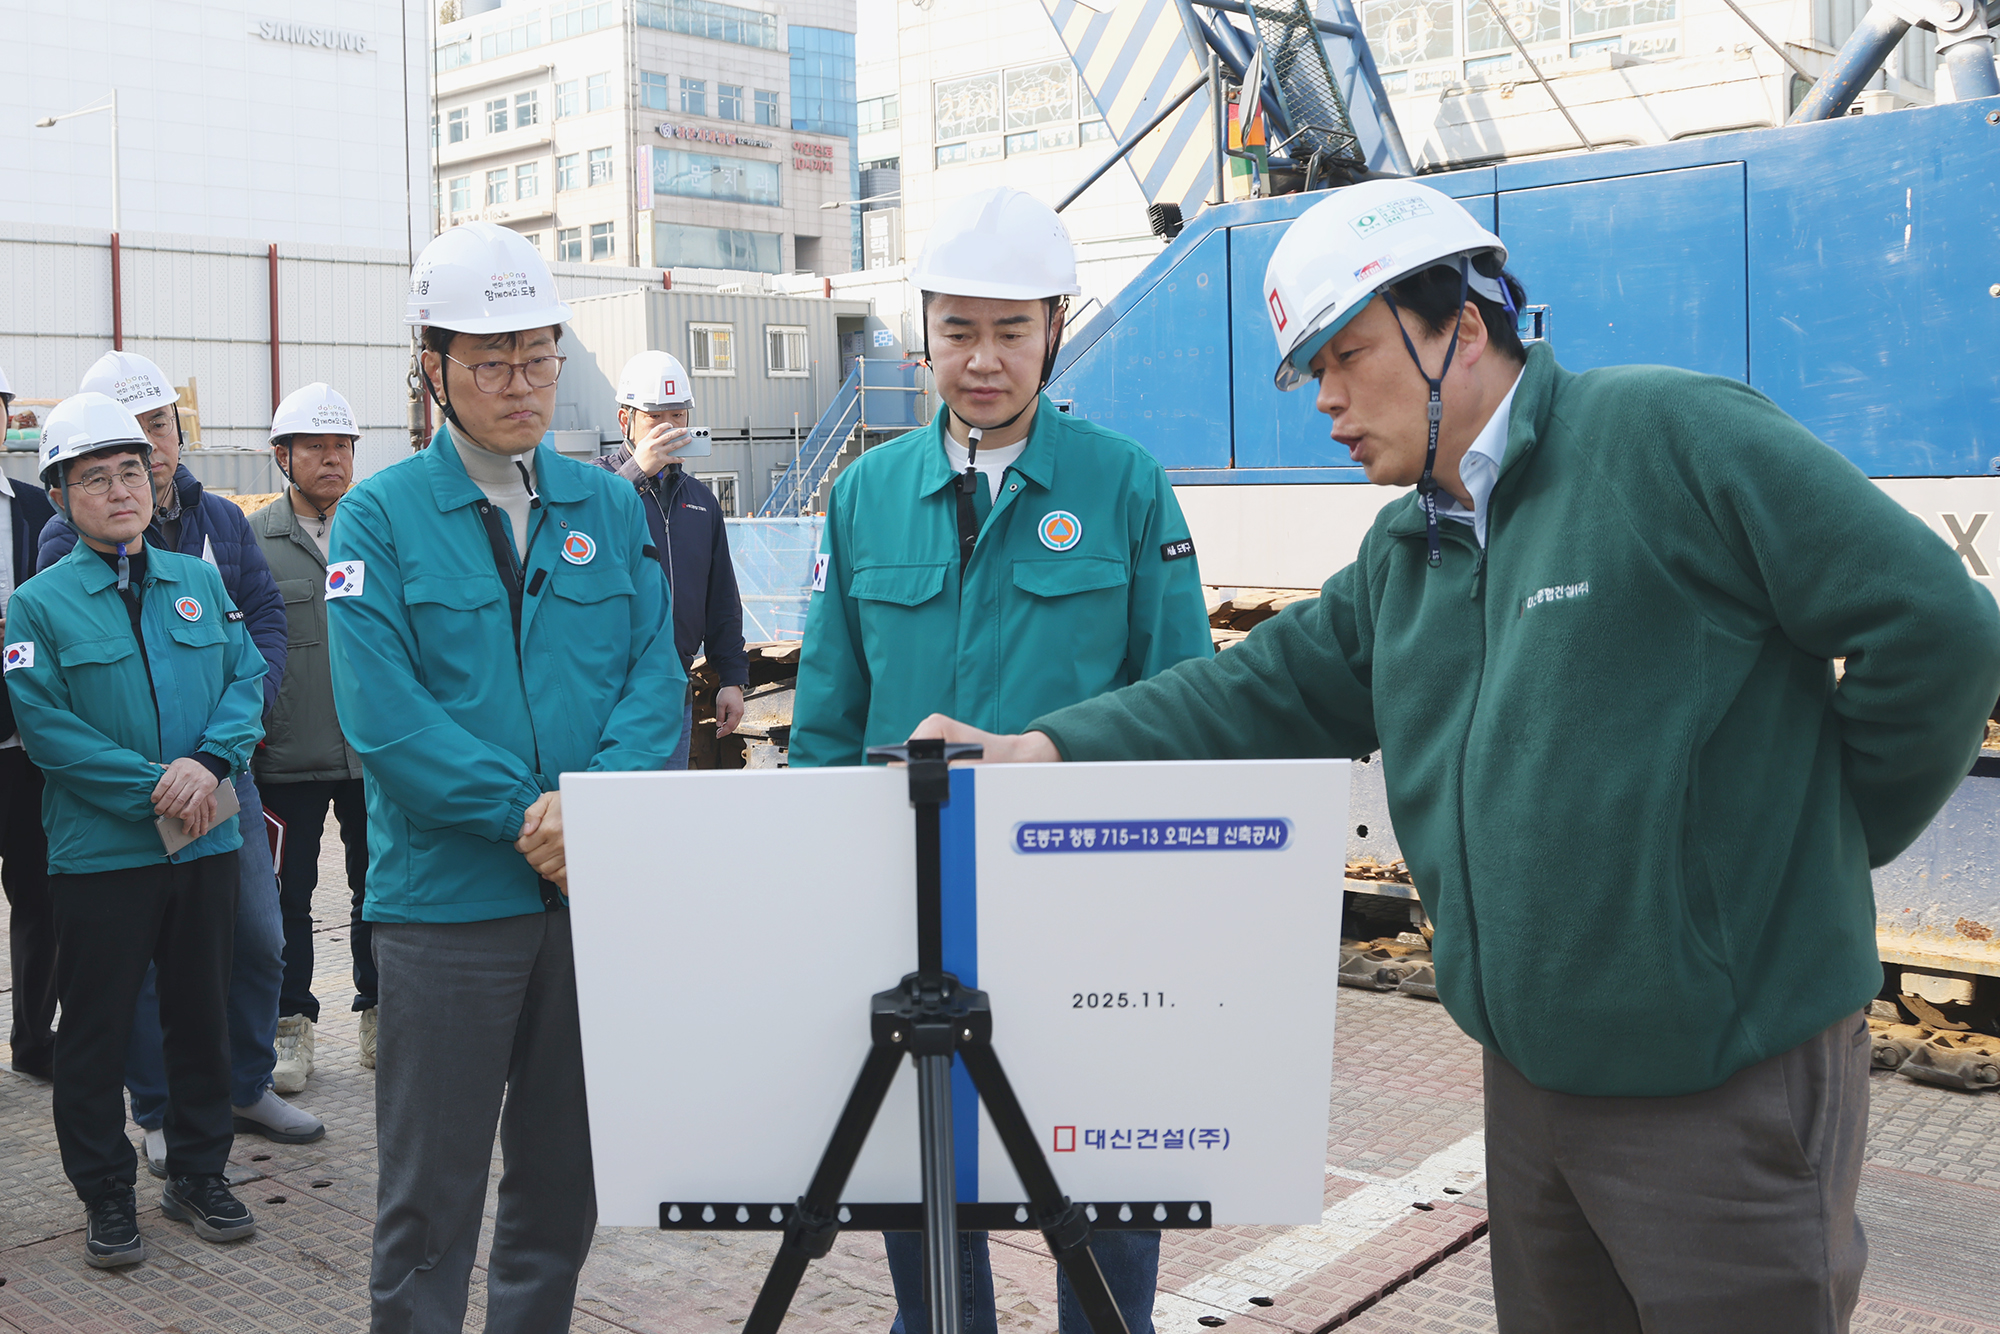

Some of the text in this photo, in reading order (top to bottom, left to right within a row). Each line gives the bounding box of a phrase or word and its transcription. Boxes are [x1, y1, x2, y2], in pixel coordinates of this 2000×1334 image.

[258, 20, 368, 54] SAMSUNG
[793, 141, 834, 159] 야간진료
[794, 157, 834, 174] 10시까지
[490, 271, 527, 282] dobong
[520, 285, 536, 298] 도봉
[1426, 491, 1437, 525] SAFETY
[1023, 825, 1281, 849] 도봉구 창동 715-13 오피스텔 신축공사
[1072, 992, 1176, 1009] 2025.11.
[1084, 1127, 1231, 1151] 대신건설(주)
